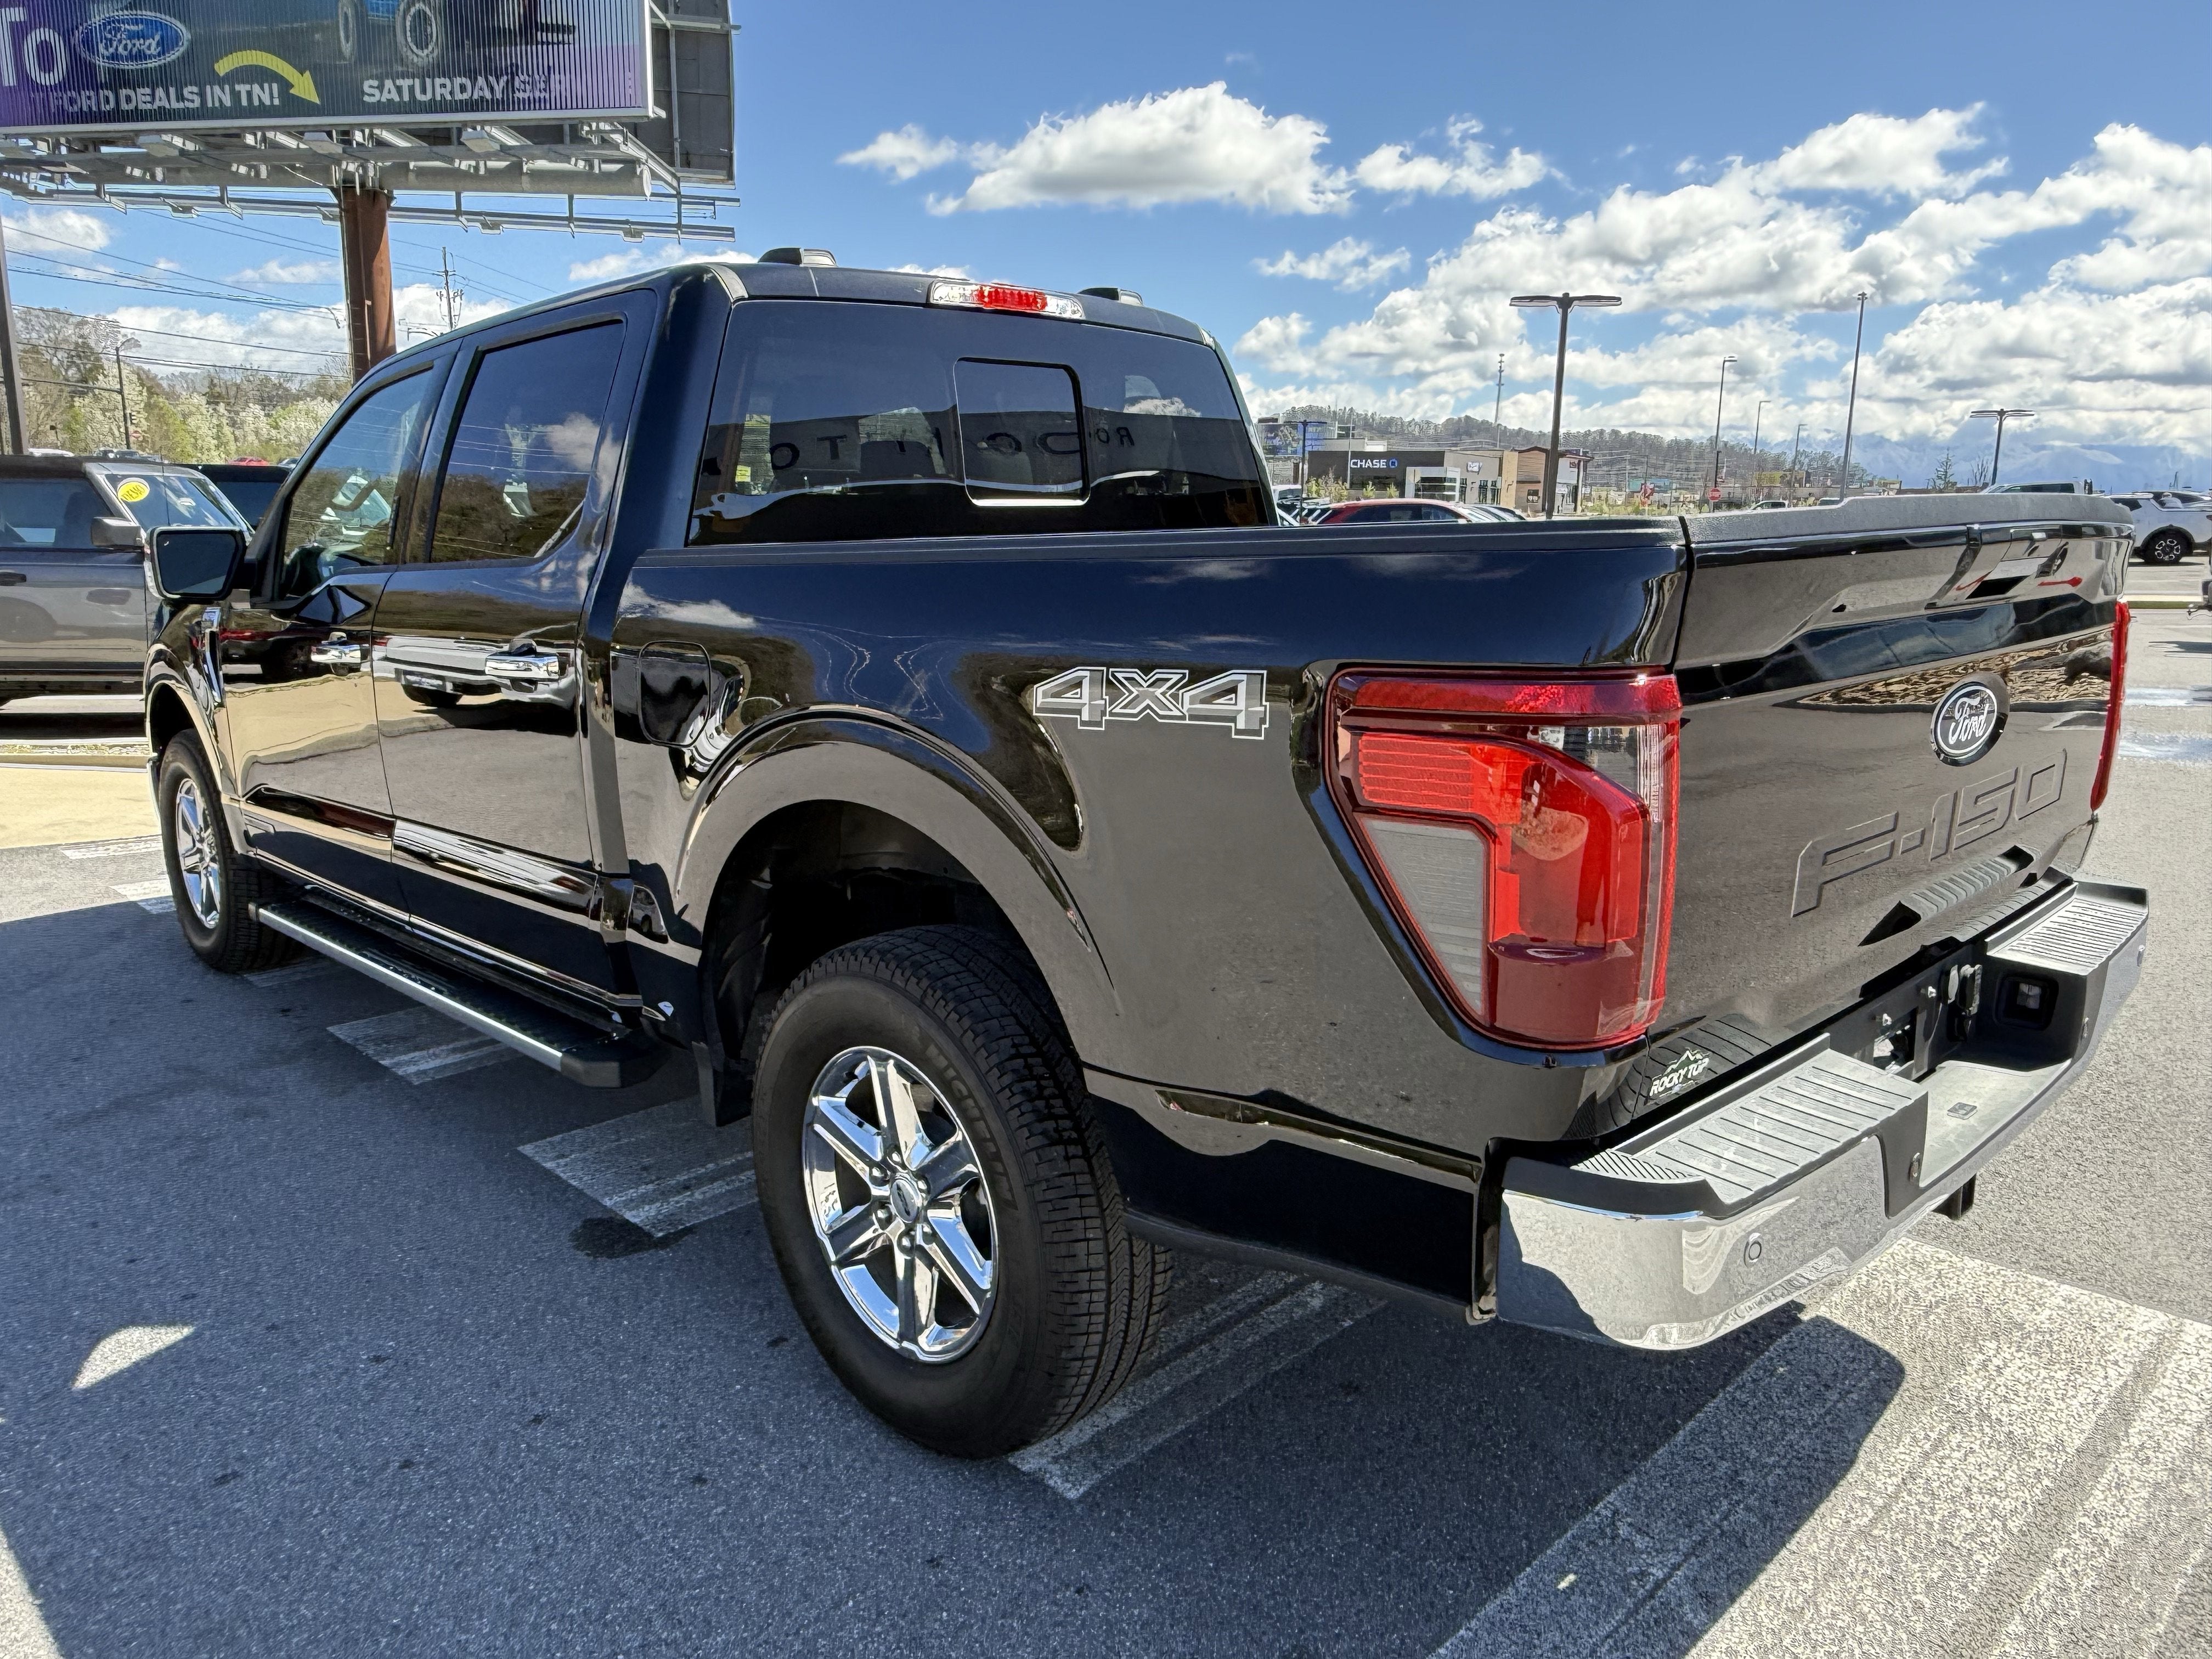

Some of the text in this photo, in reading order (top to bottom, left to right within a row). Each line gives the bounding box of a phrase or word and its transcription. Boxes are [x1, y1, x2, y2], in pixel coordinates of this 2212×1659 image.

[100, 25, 162, 54] Ford
[50, 89, 115, 112] FORD
[120, 86, 200, 110] DEALS
[206, 85, 232, 107] IN
[235, 83, 280, 105] TN!
[362, 74, 509, 103] SATURDAY
[1350, 459, 1387, 468] CHASE
[1948, 695, 1990, 744] Ford
[1790, 748, 2068, 918] F-150
[1649, 1058, 1709, 1096] ROCKY TOP
